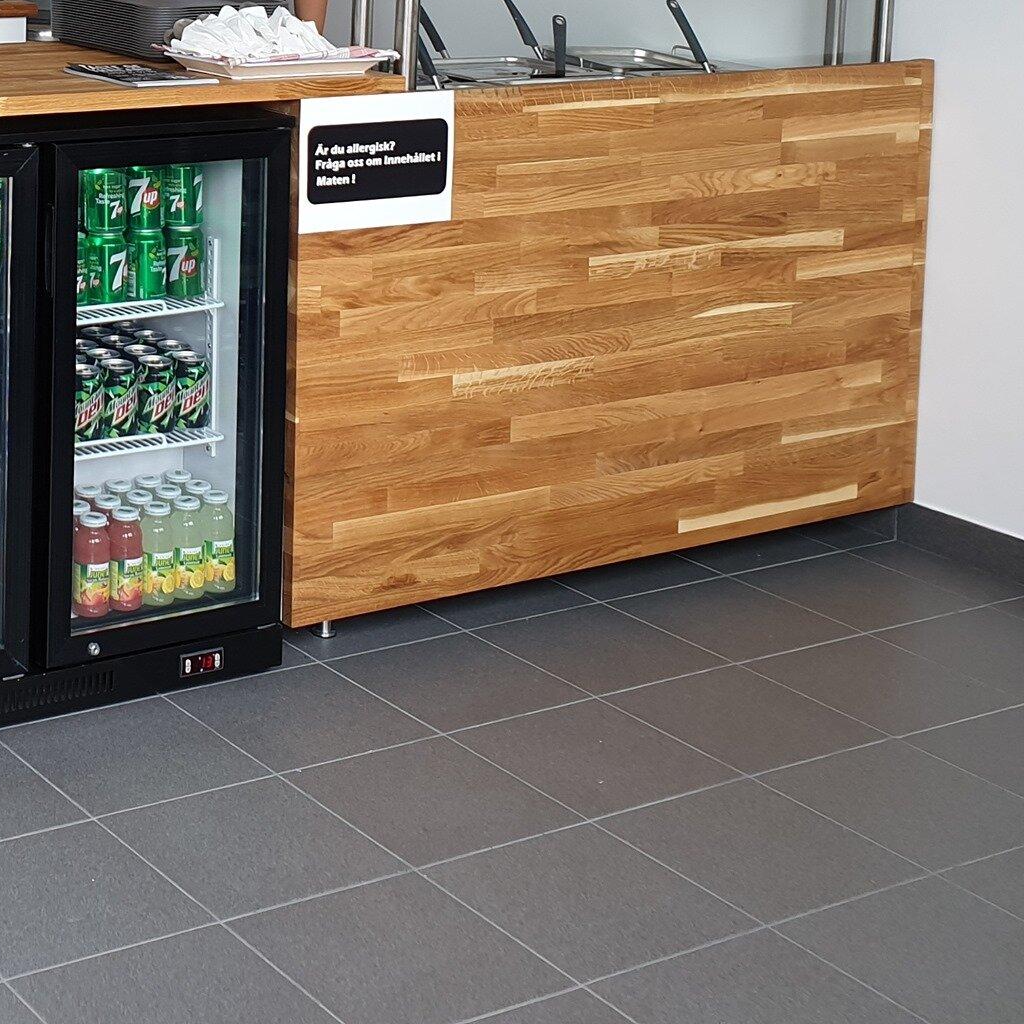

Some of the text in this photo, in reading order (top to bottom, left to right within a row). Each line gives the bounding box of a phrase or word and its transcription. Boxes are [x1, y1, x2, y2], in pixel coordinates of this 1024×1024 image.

[315, 140, 396, 156] Är du allergisk?
[315, 158, 346, 172] Fråga
[347, 159, 364, 168] oss
[365, 157, 382, 166] om
[316, 175, 350, 187] Maten
